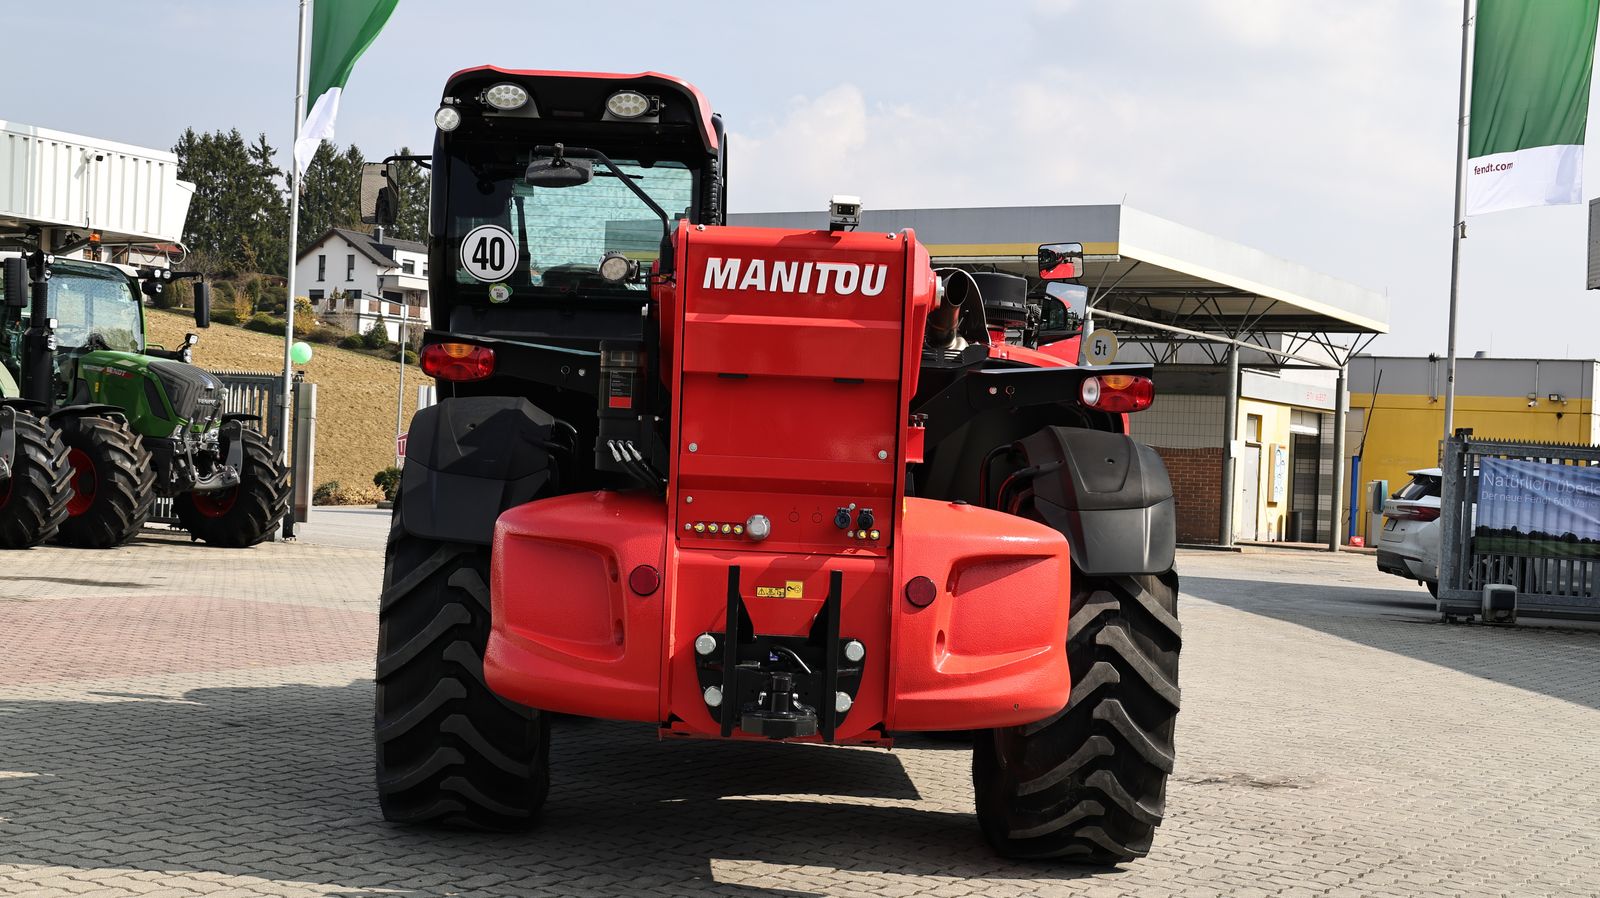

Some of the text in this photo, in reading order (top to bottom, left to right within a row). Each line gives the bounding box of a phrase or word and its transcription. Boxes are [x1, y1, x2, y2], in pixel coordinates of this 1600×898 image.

[1474, 162, 1513, 175] fendt.com
[472, 236, 505, 271] 40
[702, 257, 888, 297] MANITOU
[1483, 471, 1551, 491] Natürlich
[1482, 490, 1497, 500] Der
[1499, 493, 1522, 503] neue
[1524, 494, 1552, 505] Fendt
[1554, 496, 1571, 507] 600
